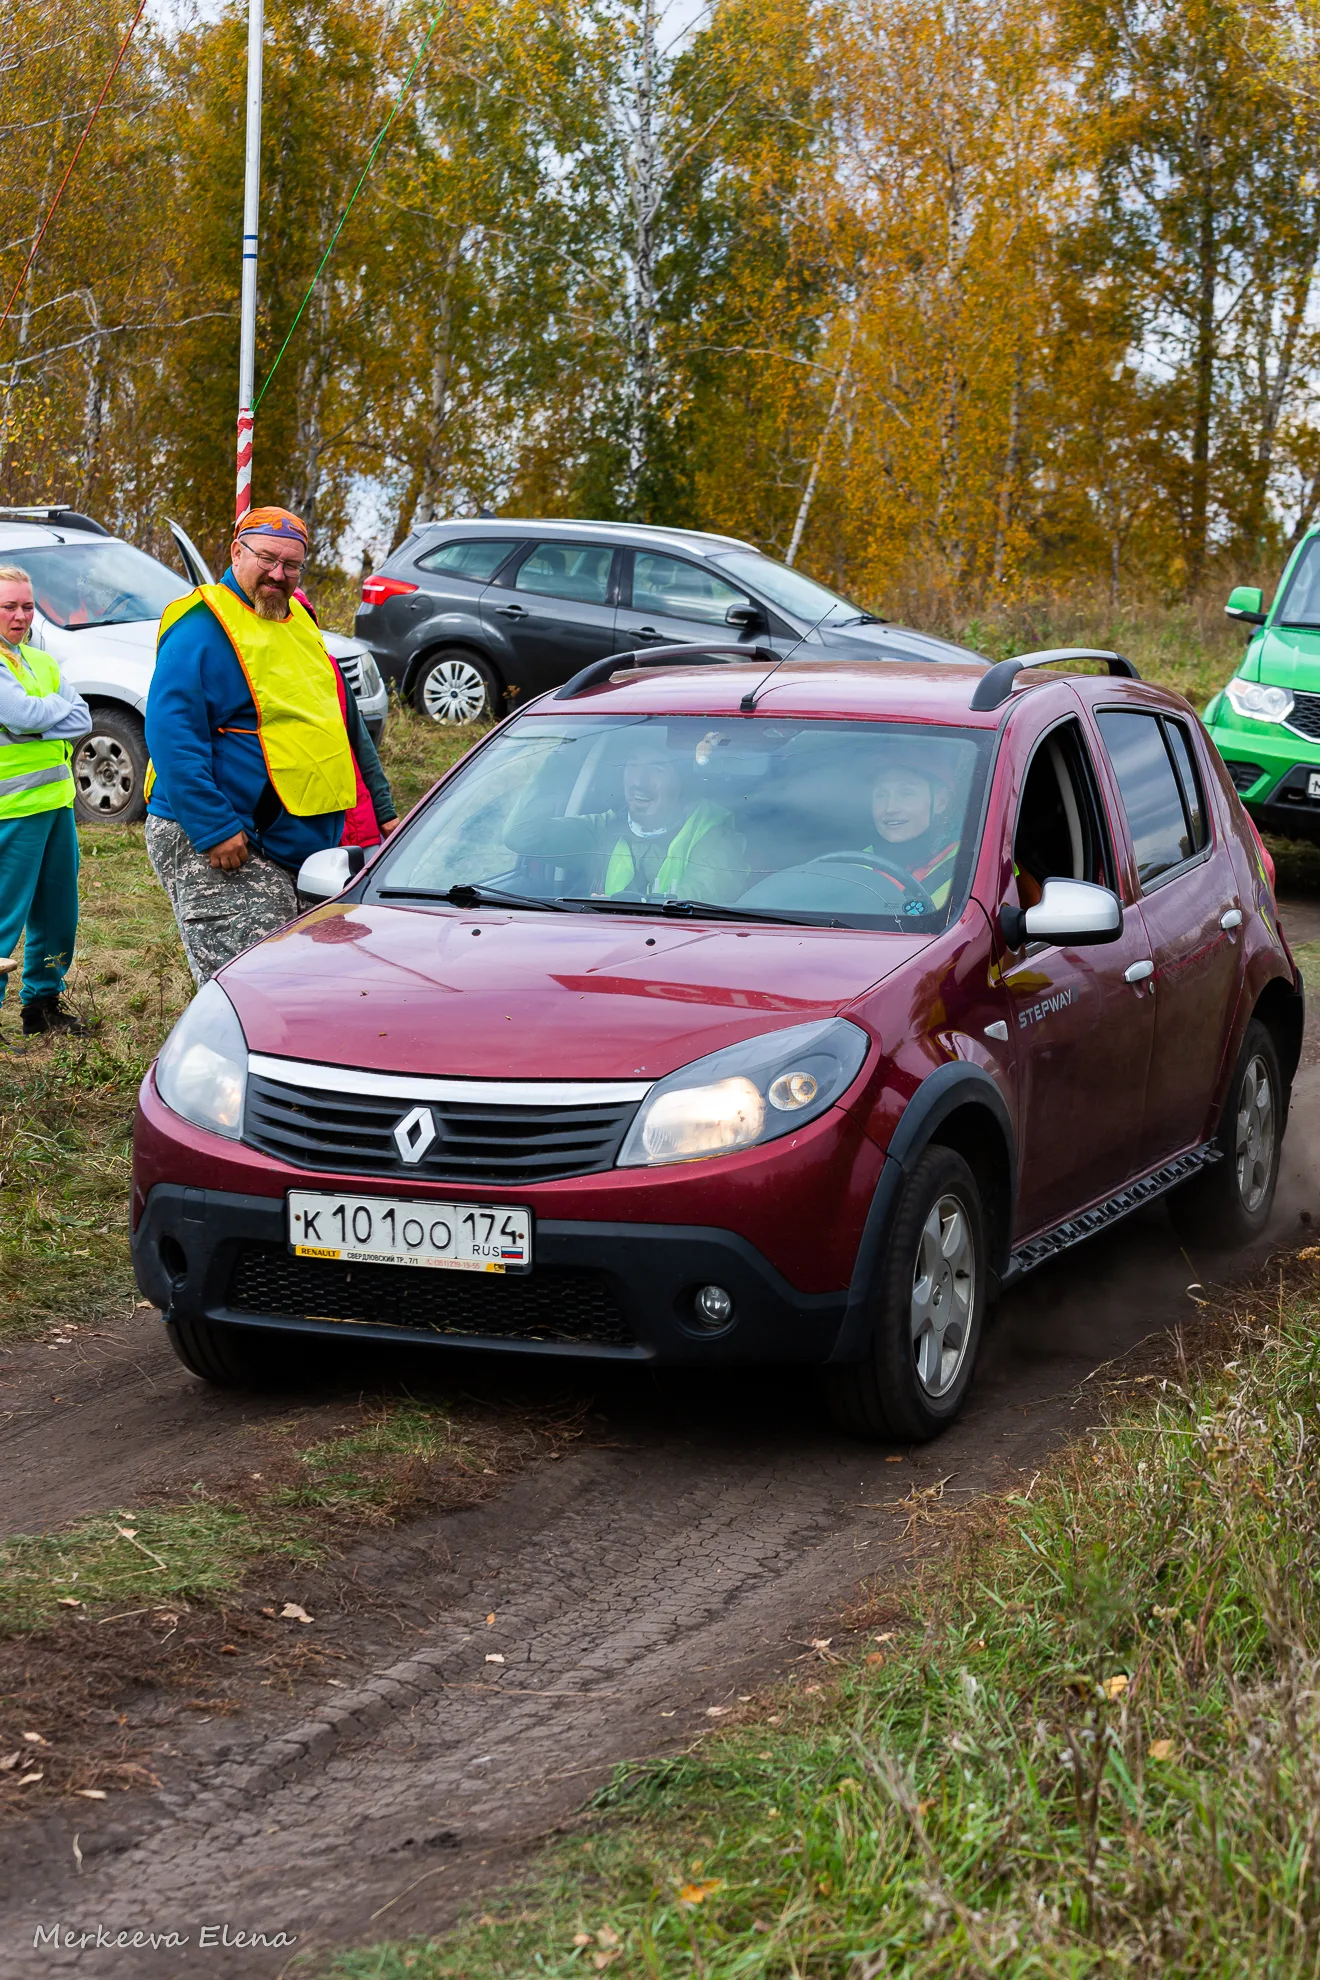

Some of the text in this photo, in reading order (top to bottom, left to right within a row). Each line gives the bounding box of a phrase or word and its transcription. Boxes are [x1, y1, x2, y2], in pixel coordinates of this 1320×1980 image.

[1018, 988, 1072, 1029] STEPWAY
[462, 1212, 518, 1245] 174
[301, 1247, 337, 1258] RENAULT
[472, 1244, 500, 1257] RUS
[347, 1252, 395, 1264] СВЕРДЛОВСКИЙ
[409, 1257, 419, 1265] 7/1
